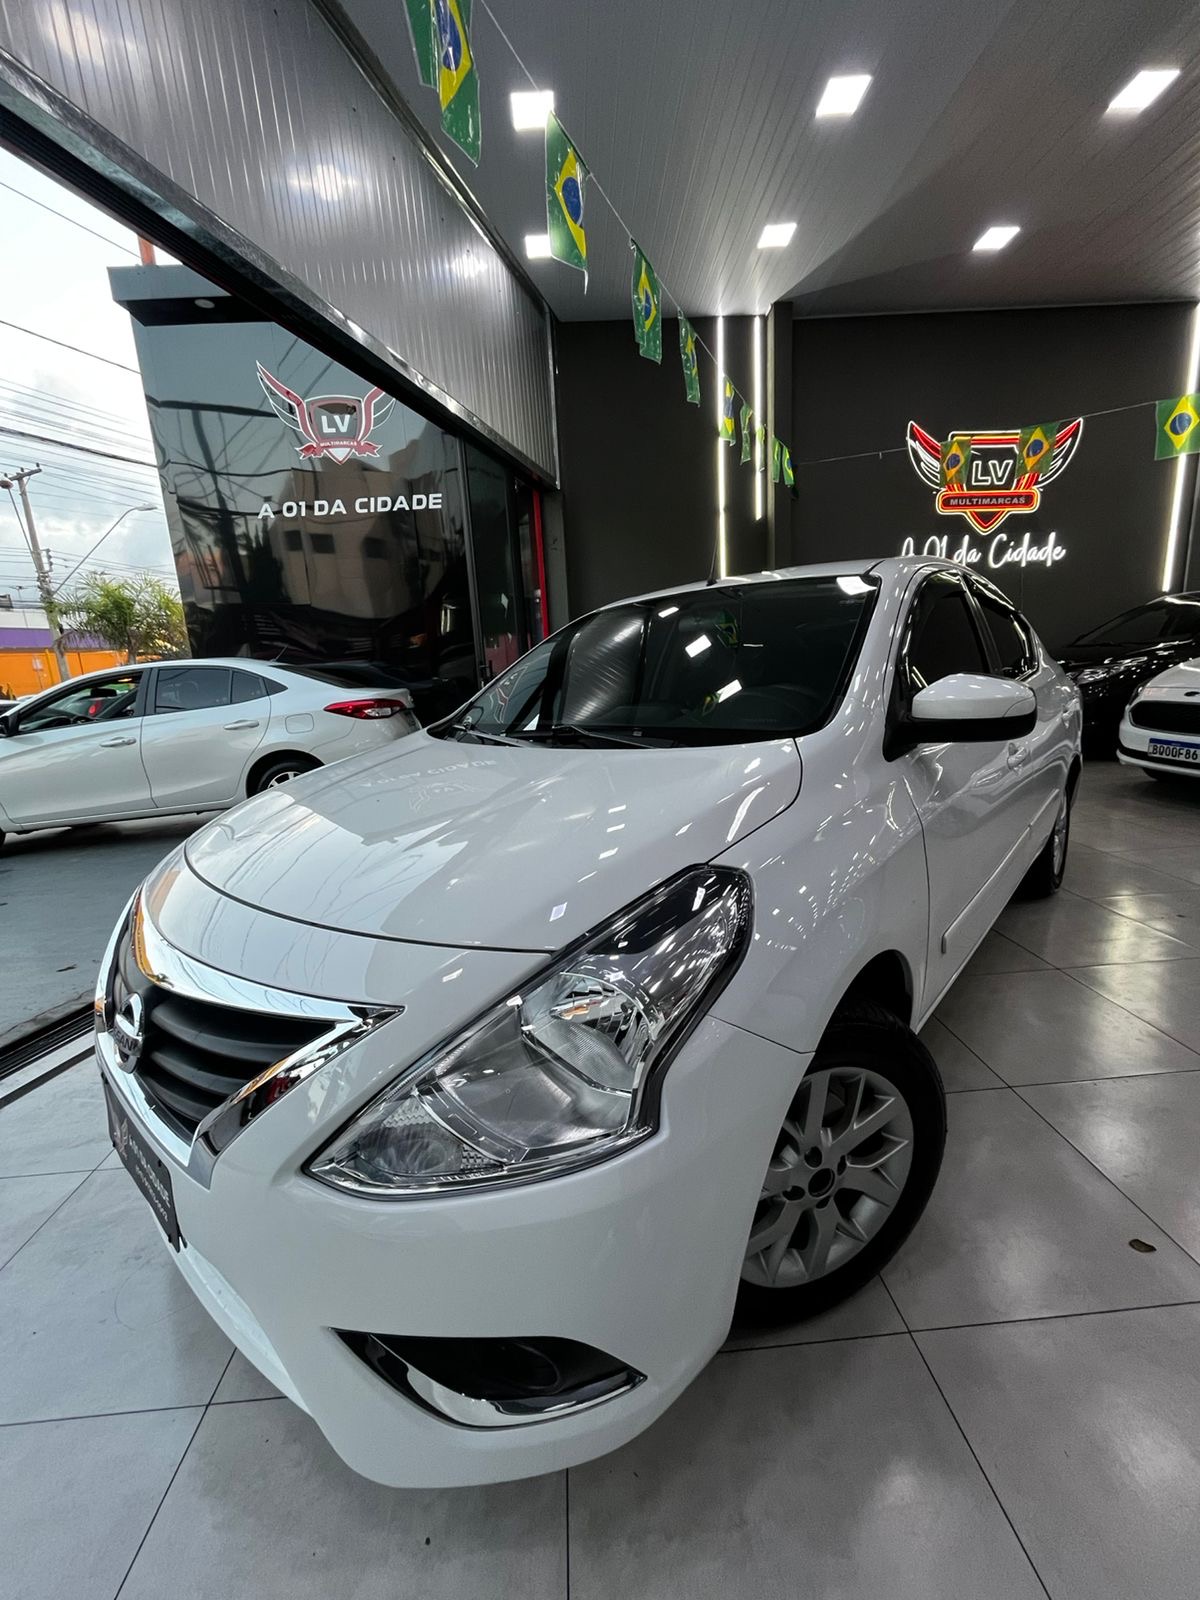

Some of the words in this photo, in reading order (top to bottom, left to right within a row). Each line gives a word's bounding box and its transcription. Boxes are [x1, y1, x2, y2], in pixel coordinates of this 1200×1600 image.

[321, 414, 350, 433] LV
[972, 460, 1013, 485] LV
[257, 503, 275, 519] A
[313, 499, 347, 516] DA
[355, 493, 442, 513] CIDADE
[950, 496, 1026, 505] MULTIMARCAS
[953, 534, 982, 567] da
[988, 532, 1067, 568] Cidade
